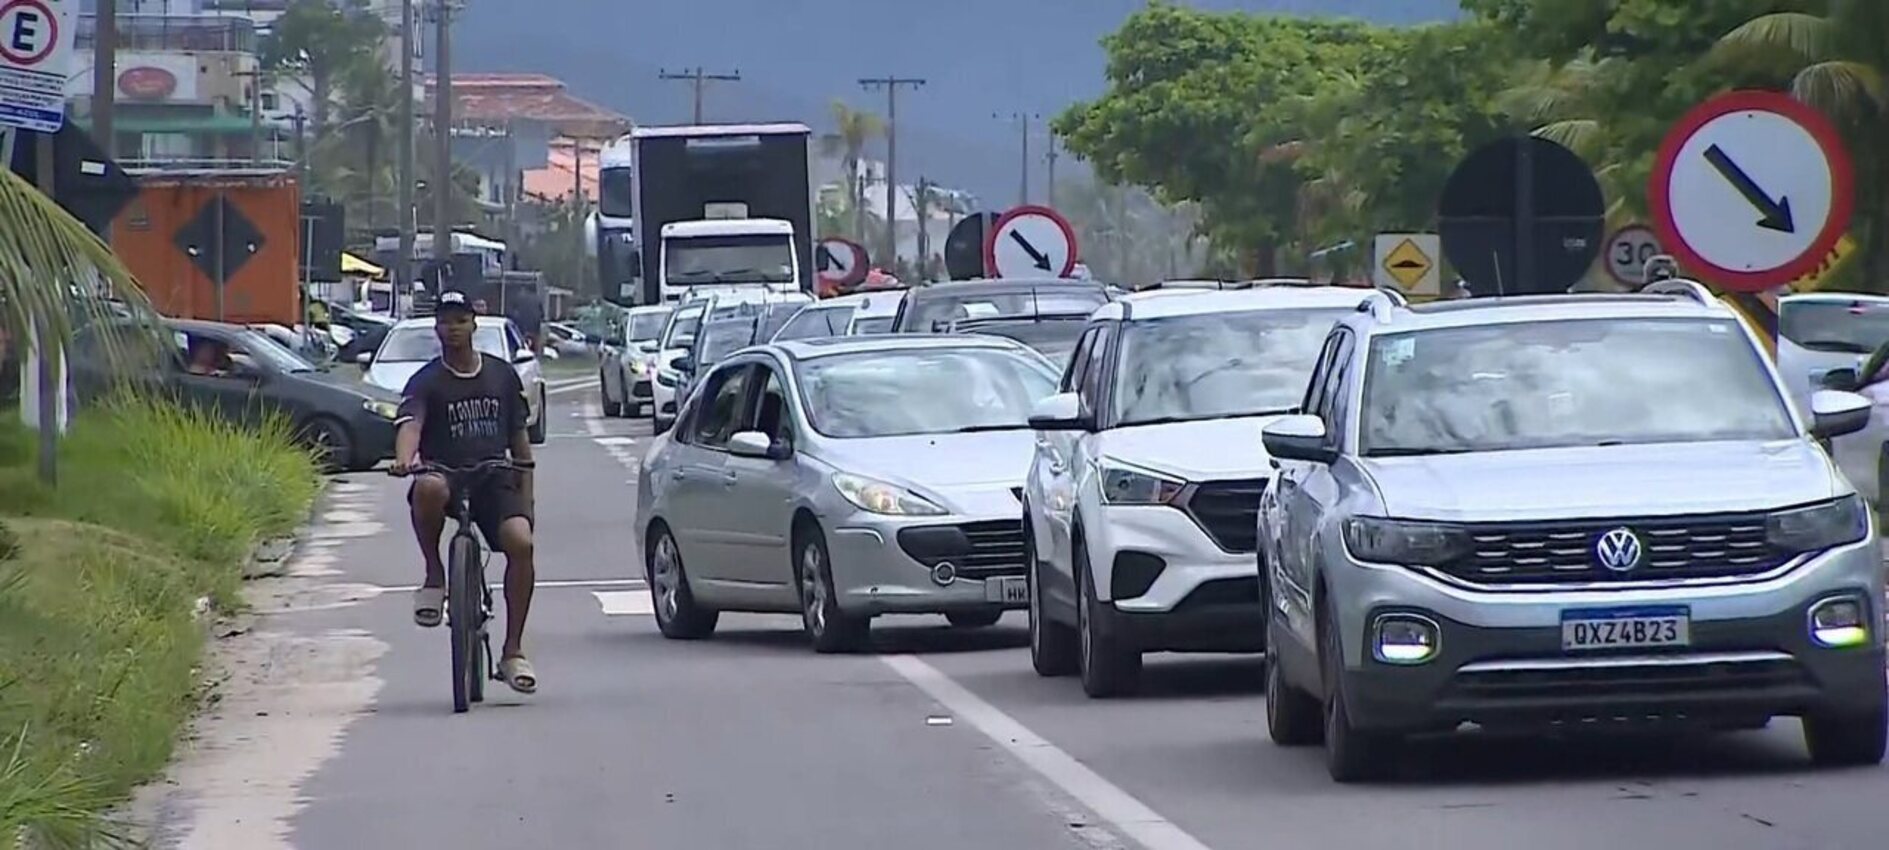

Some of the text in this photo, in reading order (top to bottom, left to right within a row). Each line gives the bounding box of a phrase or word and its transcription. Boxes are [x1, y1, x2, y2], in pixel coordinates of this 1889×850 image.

[12, 11, 38, 51] E
[1617, 242, 1656, 265] 30
[1574, 619, 1677, 645] QXZ4B23
